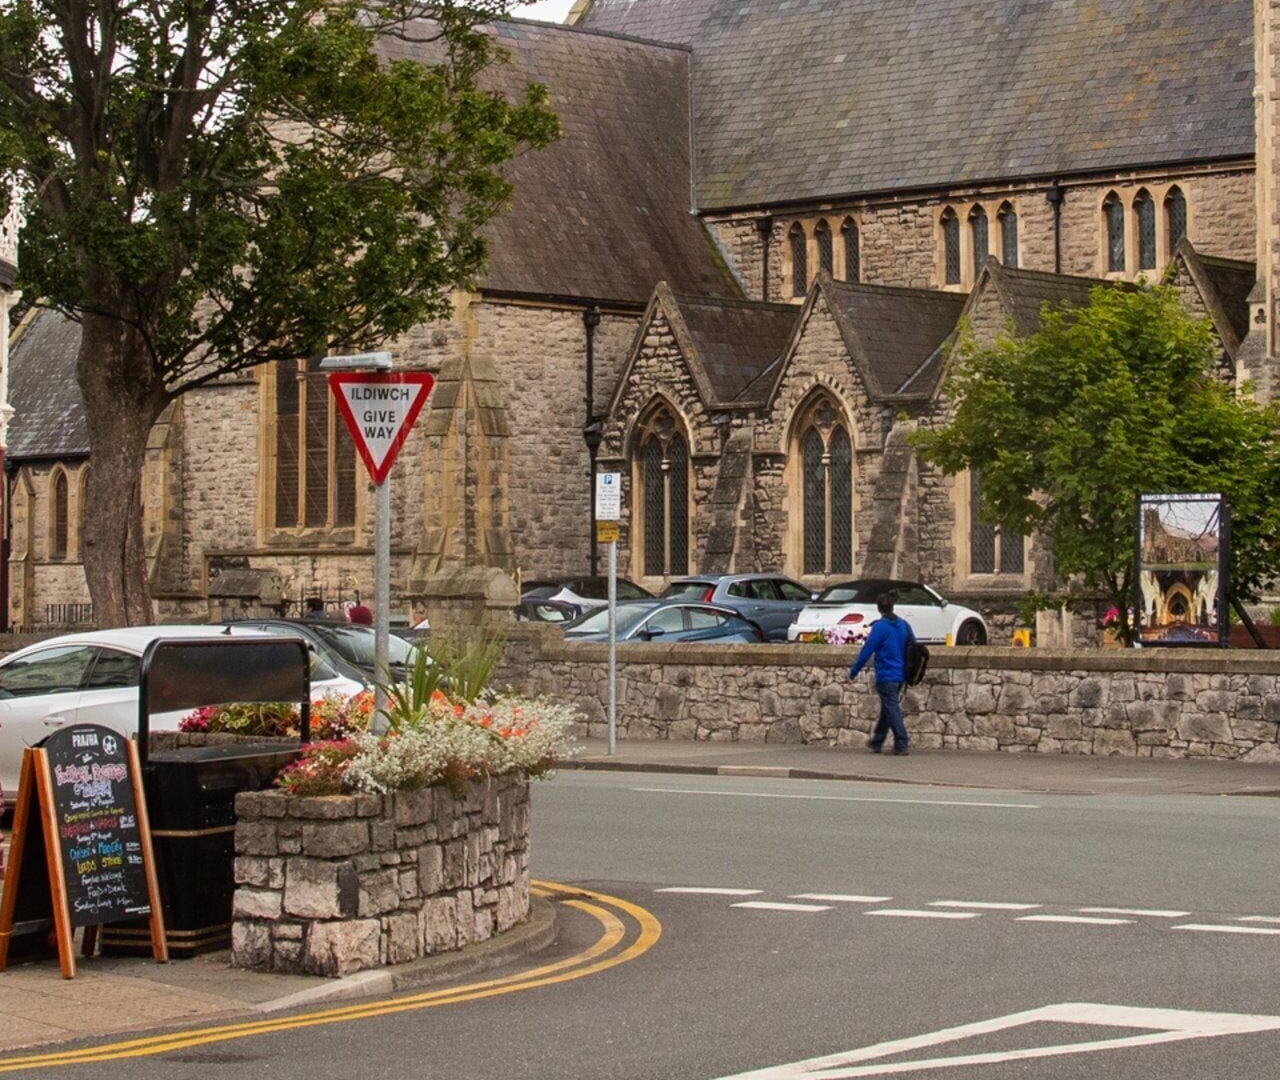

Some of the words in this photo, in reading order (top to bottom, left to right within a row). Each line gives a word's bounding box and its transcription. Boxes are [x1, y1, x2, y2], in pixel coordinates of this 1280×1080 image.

[351, 388, 409, 400] ILDIWCH
[363, 410, 396, 423] GIVE
[364, 427, 394, 439] WAY
